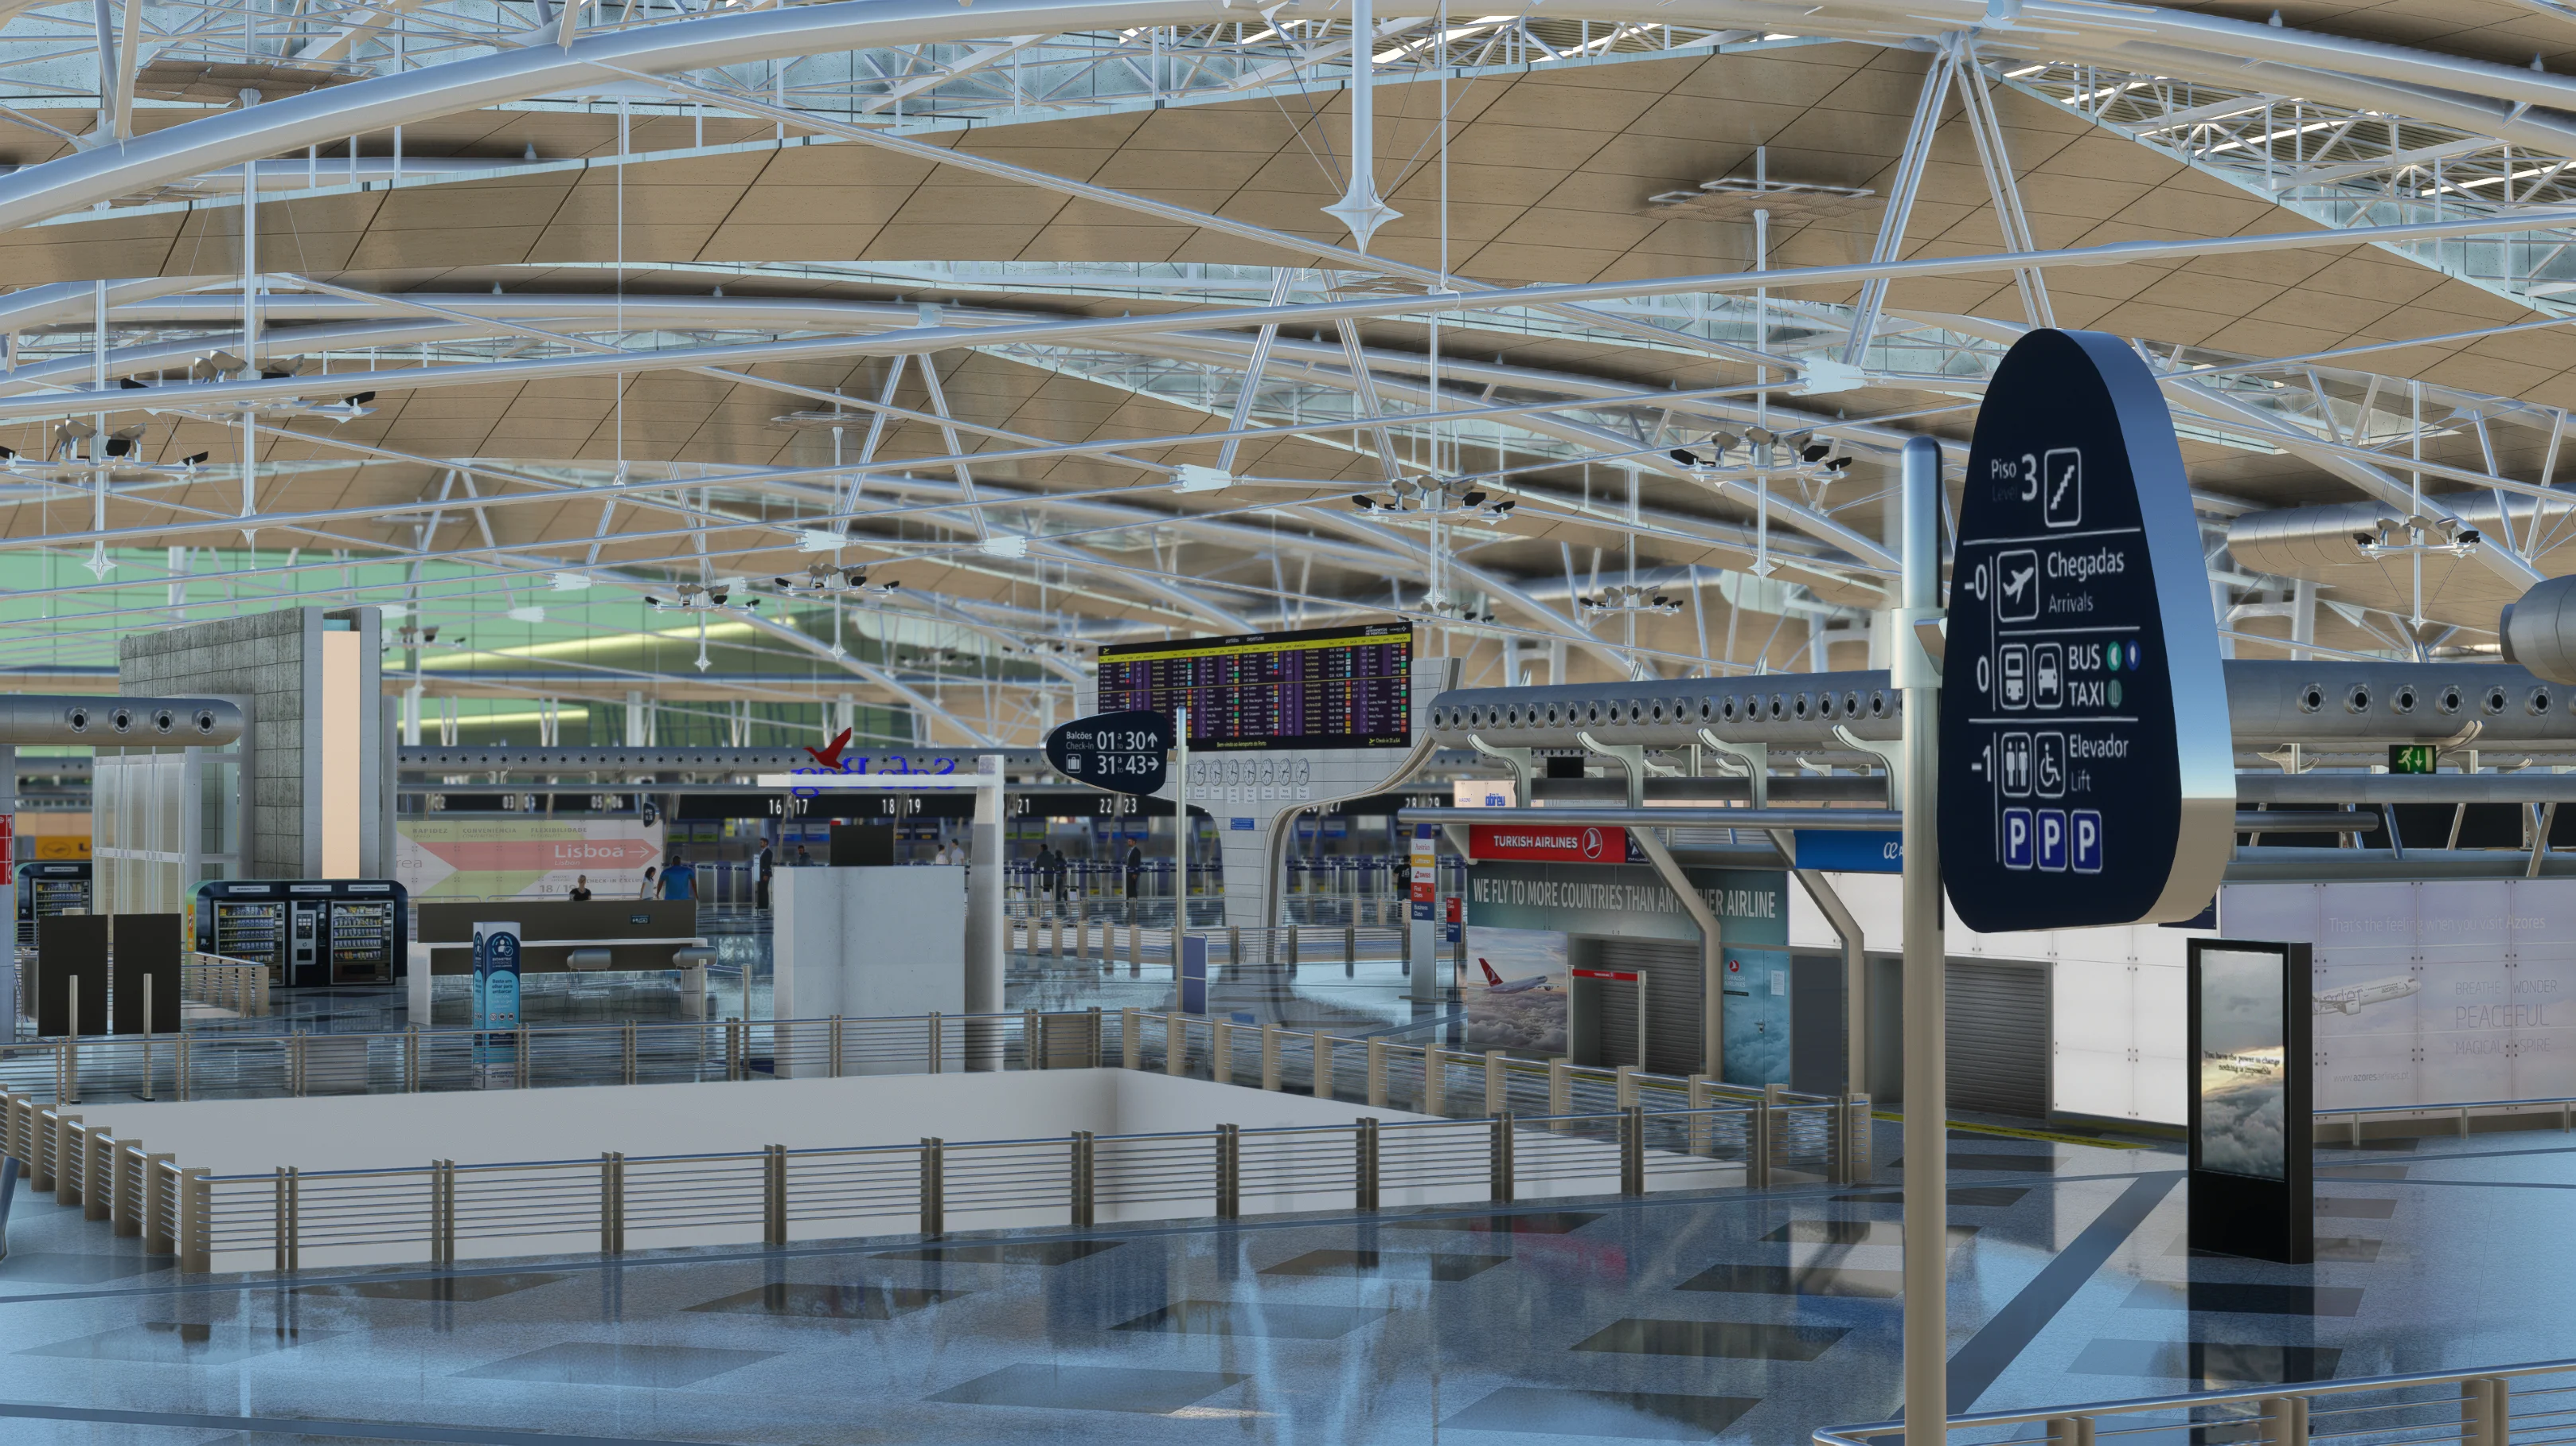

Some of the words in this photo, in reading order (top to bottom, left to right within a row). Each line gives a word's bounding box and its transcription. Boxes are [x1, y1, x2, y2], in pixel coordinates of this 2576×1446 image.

[1991, 458, 2016, 479] Piso
[2021, 453, 2038, 501] 3
[2047, 547, 2125, 582] Chegadas
[2048, 591, 2094, 613] Arrivals
[1977, 655, 1990, 693] 0
[2069, 643, 2102, 670] BUS
[2068, 681, 2105, 707] TAXI
[1066, 731, 1093, 740] Balcões
[1097, 731, 1114, 750] 01
[1126, 731, 1146, 750] 30
[1097, 755, 1114, 775] 31
[1126, 755, 1146, 775] 43
[1971, 744, 1991, 782] -1
[2070, 733, 2129, 758] Elevador
[2071, 768, 2091, 791] Lift
[769, 799, 782, 815] 16
[795, 799, 808, 815] 17
[882, 799, 895, 814] 18
[908, 799, 921, 814] 19
[1017, 799, 1030, 814] 21
[1099, 799, 1112, 814] 22
[1124, 798, 1137, 813] 23
[1405, 797, 1417, 808] 28
[1493, 835, 1533, 847] TURKISH
[1535, 836, 1578, 849] AIRLINES
[554, 843, 624, 858] Lisboa
[396, 858, 423, 869] rea
[1473, 878, 1489, 903] WE
[1492, 879, 1509, 904] FLY
[1511, 880, 1525, 905] TO
[1528, 881, 1559, 907] MORE
[1560, 881, 1623, 911] COUNTRIES
[1626, 885, 1655, 913] THAN
[1726, 889, 1776, 919] AIRLINE
[2328, 917, 2362, 932] That's
[2364, 917, 2383, 932] the
[2385, 916, 2424, 936] feeling
[2427, 916, 2455, 932] when
[2457, 918, 2477, 935] you
[2479, 915, 2504, 930] visit
[2507, 915, 2547, 930] Azores
[2455, 981, 2500, 995] BREATHE
[2513, 979, 2558, 994] WONDER
[2455, 1003, 2551, 1029] PEACEFUL
[2455, 1039, 2504, 1056] MAGICAL
[2262, 1057, 2281, 1068] change
